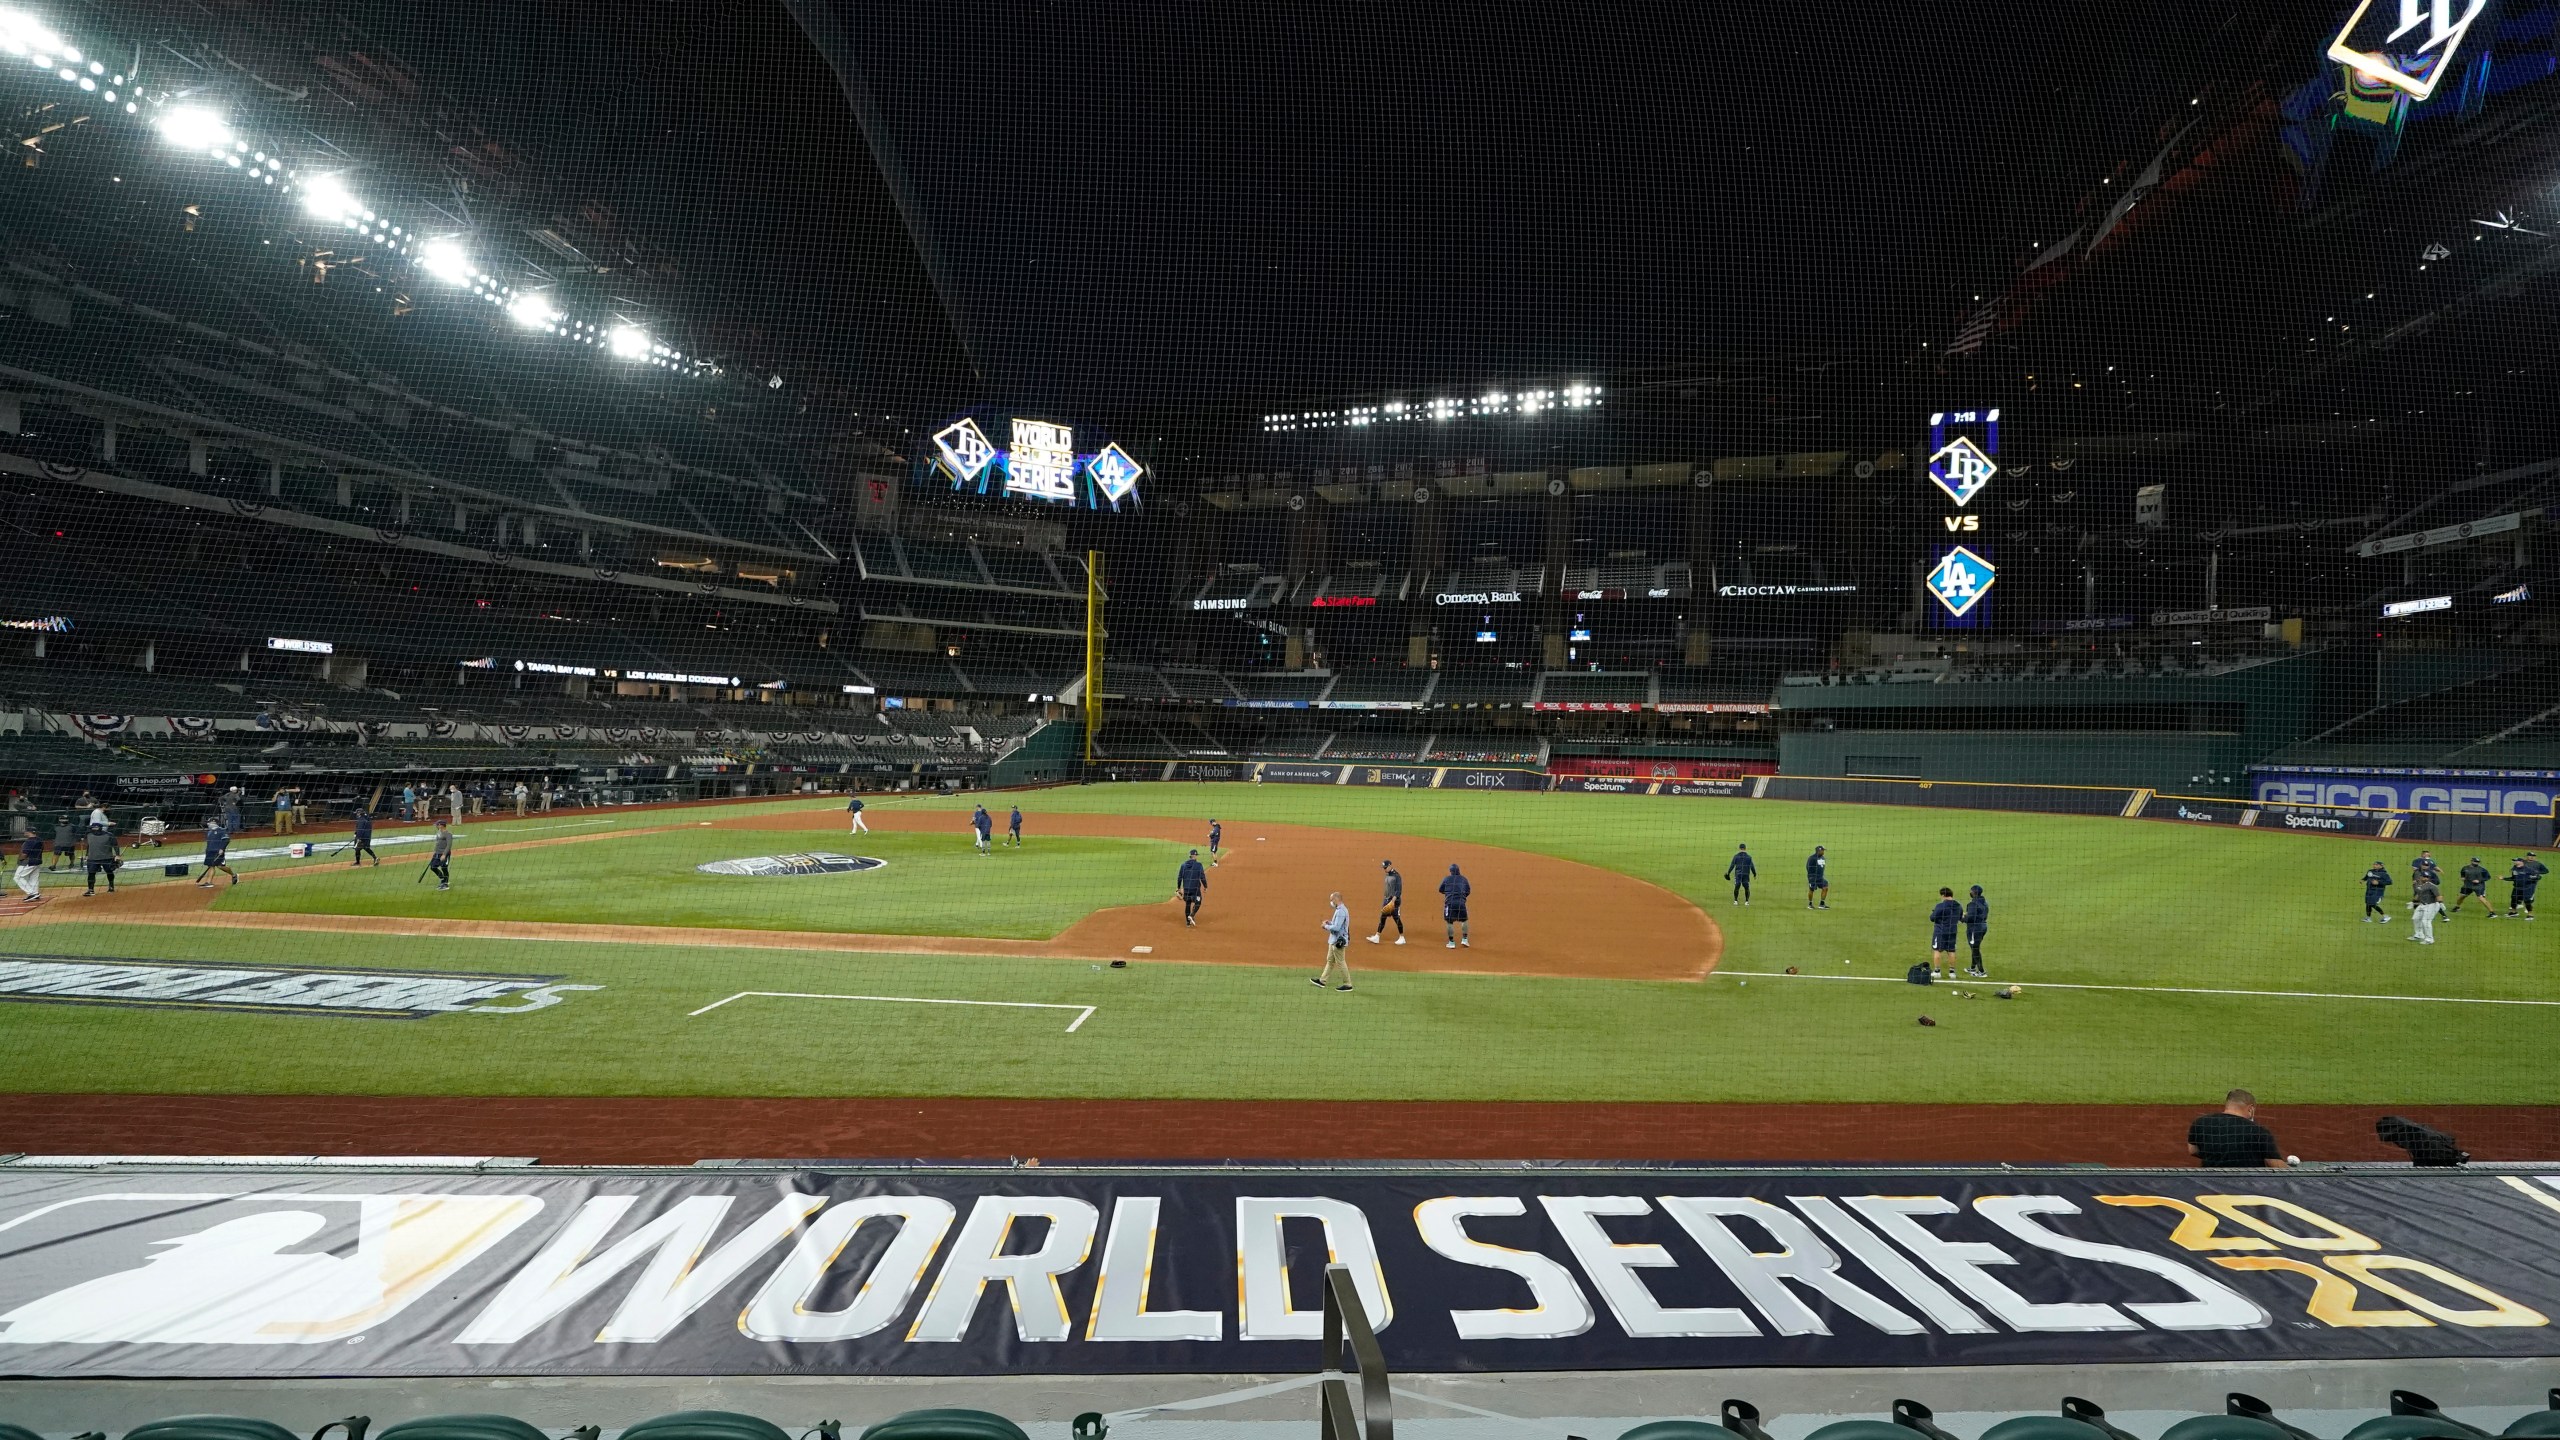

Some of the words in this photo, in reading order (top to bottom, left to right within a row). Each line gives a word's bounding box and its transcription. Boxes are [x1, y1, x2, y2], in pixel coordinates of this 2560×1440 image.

[1012, 422, 1072, 451] WORLD
[951, 424, 987, 467] TB
[1100, 449, 1125, 486] LA
[1941, 447, 1985, 489] TB
[1007, 461, 1076, 495] SERIES
[1940, 555, 1976, 598] LA
[1491, 591, 1521, 602] Bank
[1578, 590, 1603, 599] Coca-Cola
[1648, 588, 1670, 596] Coca-Cola
[1727, 585, 1796, 596] CHOCTAW
[1194, 599, 1247, 610] SAMSUNG
[2229, 609, 2269, 619] QuikTrip
[527, 662, 556, 673] TAMPA
[557, 665, 573, 675] BAY
[574, 666, 596, 677] RAYS
[626, 671, 645, 680] LOS
[646, 672, 688, 682] ANGELES
[688, 675, 729, 685] DODGERS
[1658, 704, 1708, 712] WHATABURGER
[1713, 704, 1765, 712] WHATABURGER
[1584, 782, 1623, 791] Spectrum
[1682, 787, 1708, 795] Security
[2259, 782, 2398, 818] GEICO
[2410, 787, 2560, 815] GEIC
[2187, 811, 2212, 821] BayCare
[2285, 814, 2340, 829] Spectrum
[453, 1194, 1393, 1344] WORLD
[1414, 1194, 2273, 1340] SERIES
